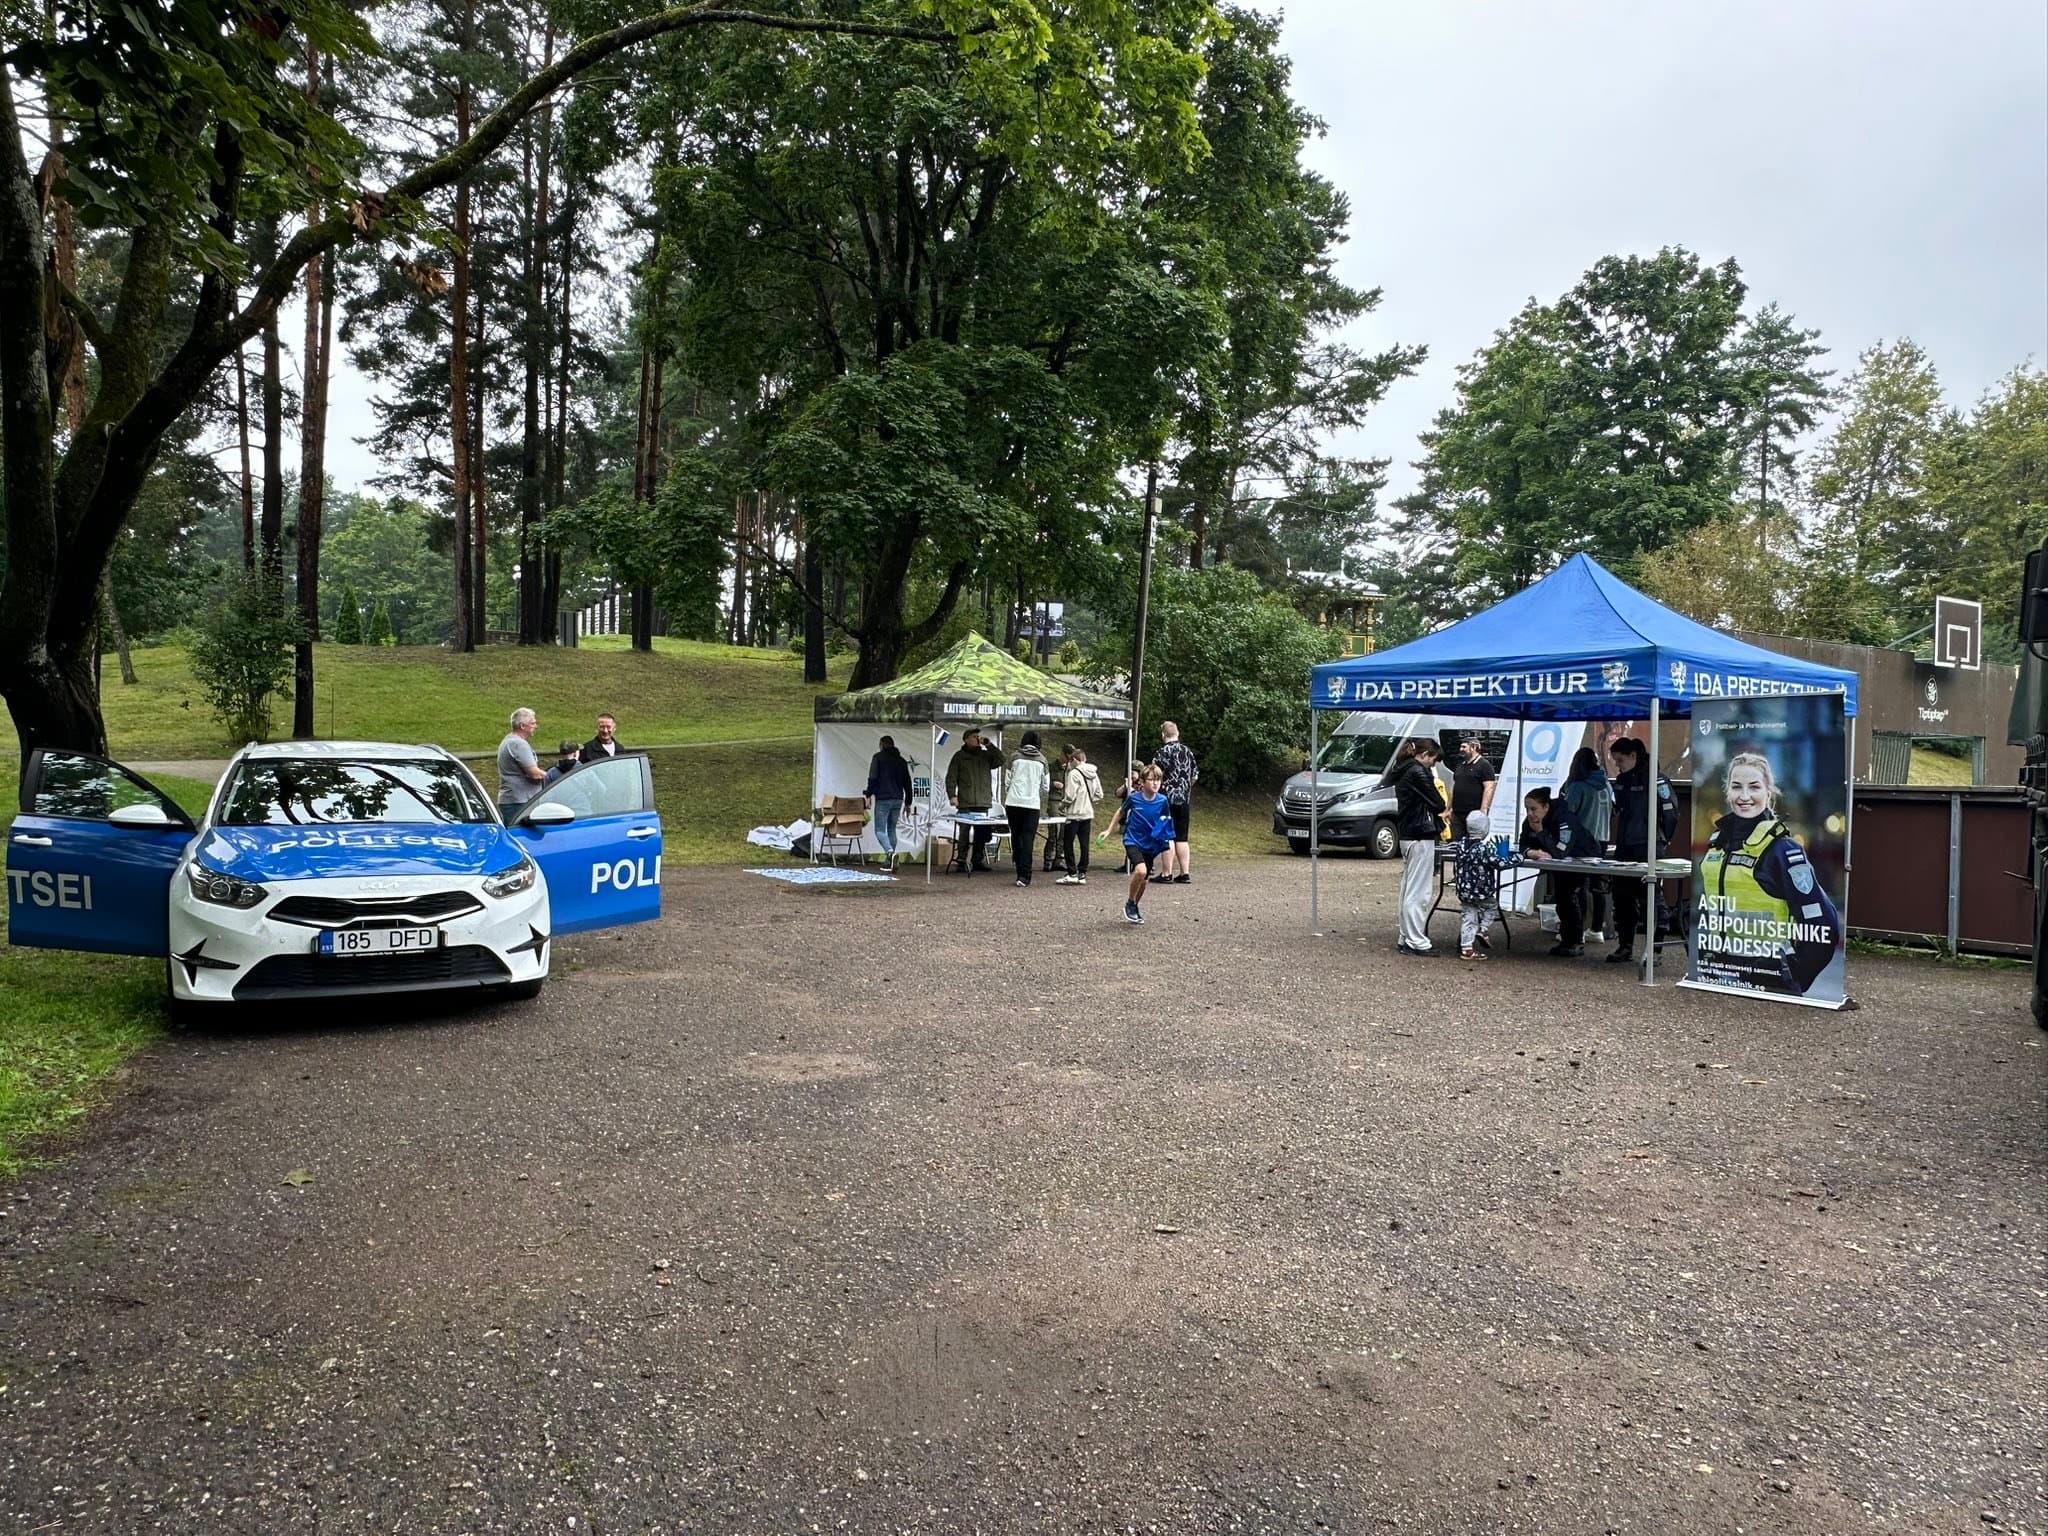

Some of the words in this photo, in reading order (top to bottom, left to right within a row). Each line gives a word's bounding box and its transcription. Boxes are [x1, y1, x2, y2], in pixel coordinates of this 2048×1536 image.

[1355, 681, 1394, 701] IDA
[1400, 672, 1588, 700] PREFEKTUUR
[1694, 672, 1724, 697] IDA
[270, 834, 469, 854] POLITSEI
[591, 855, 661, 894] POLI
[7, 869, 93, 910] TSEI
[1698, 893, 1736, 912] ASTU
[338, 932, 371, 950] 185
[389, 929, 432, 948] DFD
[1698, 914, 1831, 944] ABIPOLITSEINIKE
[1698, 933, 1782, 959] RIDADESSE
